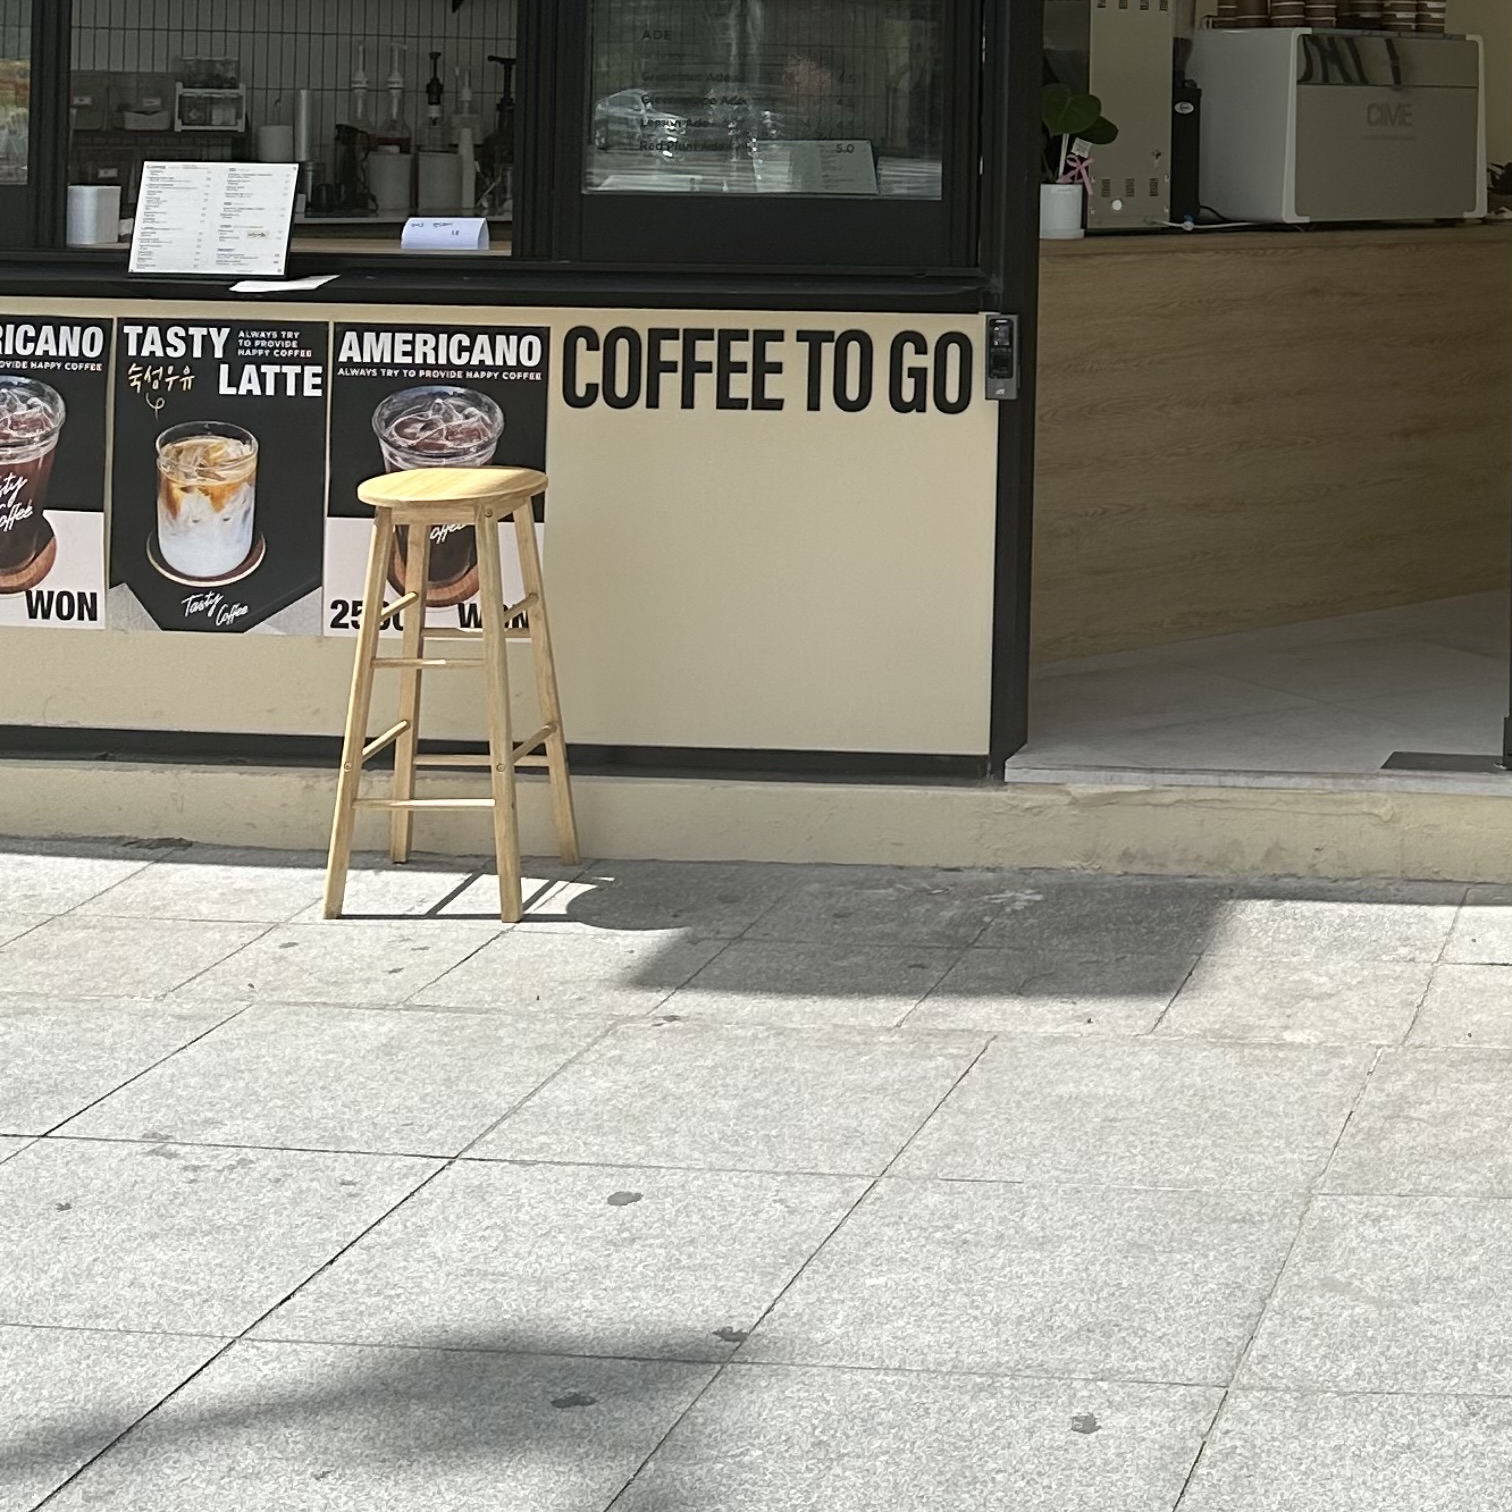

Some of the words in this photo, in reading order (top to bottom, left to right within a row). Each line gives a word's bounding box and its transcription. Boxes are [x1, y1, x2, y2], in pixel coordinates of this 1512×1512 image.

[641, 29, 673, 41] ADE
[1366, 102, 1413, 127] CIME
[639, 140, 662, 152] Red
[836, 143, 855, 154] 5.0
[124, 326, 230, 359] TASTY
[238, 330, 278, 338] ALWAYS
[281, 331, 300, 339] TRY
[238, 339, 251, 347] TO
[254, 340, 298, 348] PROVIDE
[237, 349, 270, 357] HAPPY
[273, 349, 312, 358] COFFEE
[338, 331, 542, 367] AMERICANO
[30, 361, 62, 370] HAPPY
[65, 363, 103, 371] COFFEE
[128, 363, 195, 394] 숙성우유
[337, 367, 378, 377] ALWAYS
[381, 368, 399, 378] TRY
[403, 369, 416, 378] TO
[419, 369, 463, 379] PROVIDE
[466, 371, 499, 380] HAPPY
[502, 371, 542, 381] COFFEE
[562, 325, 785, 411] COFFEE
[796, 329, 873, 413] TO
[889, 330, 973, 414] GO
[218, 364, 323, 397] LATTE
[26, 590, 98, 621] WON
[181, 591, 224, 617] Tasty
[216, 603, 248, 626] Coffee
